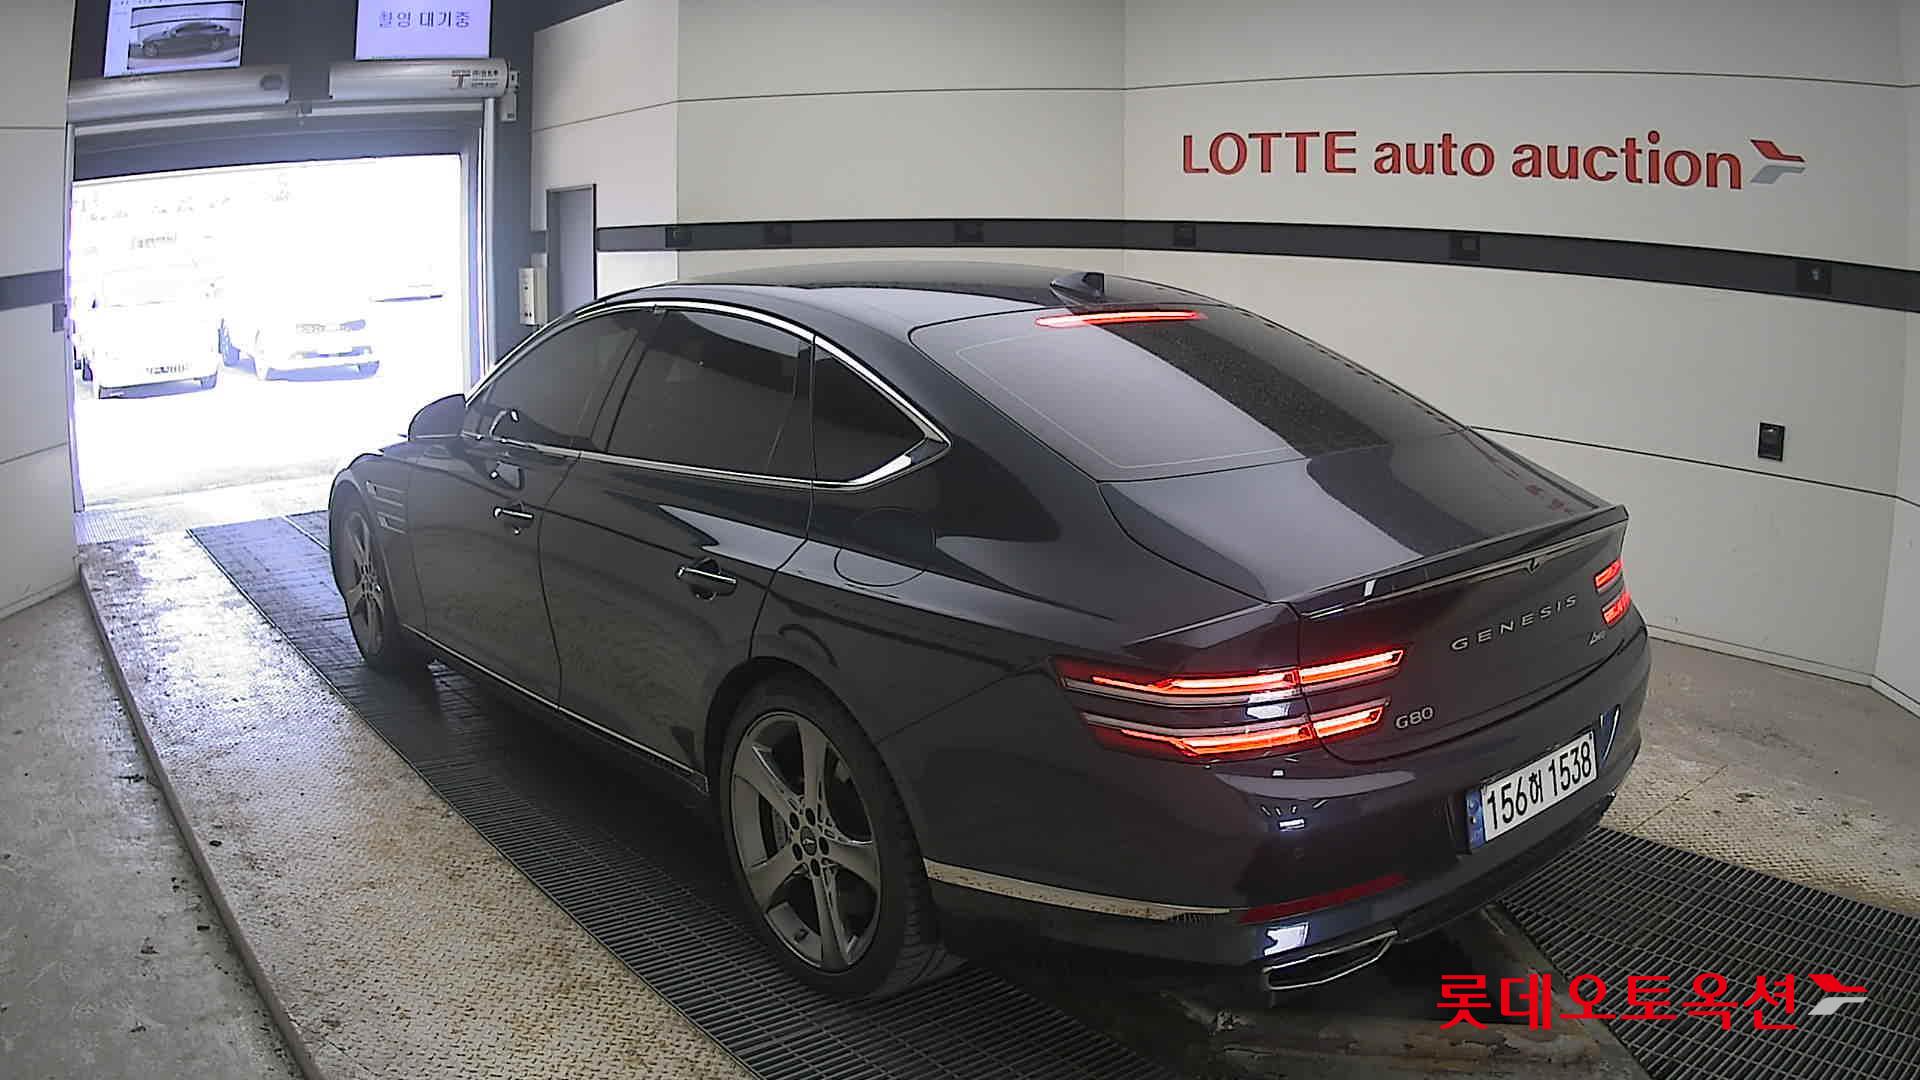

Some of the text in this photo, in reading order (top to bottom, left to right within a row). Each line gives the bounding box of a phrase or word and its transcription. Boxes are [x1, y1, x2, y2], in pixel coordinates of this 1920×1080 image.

[419, 11, 471, 28] 대기중
[1182, 130, 1742, 189] LOTTE auto auction
[1450, 594, 1578, 651] GENESIS
[1395, 706, 1434, 729] G80
[1487, 741, 1592, 830] 156허 1538
